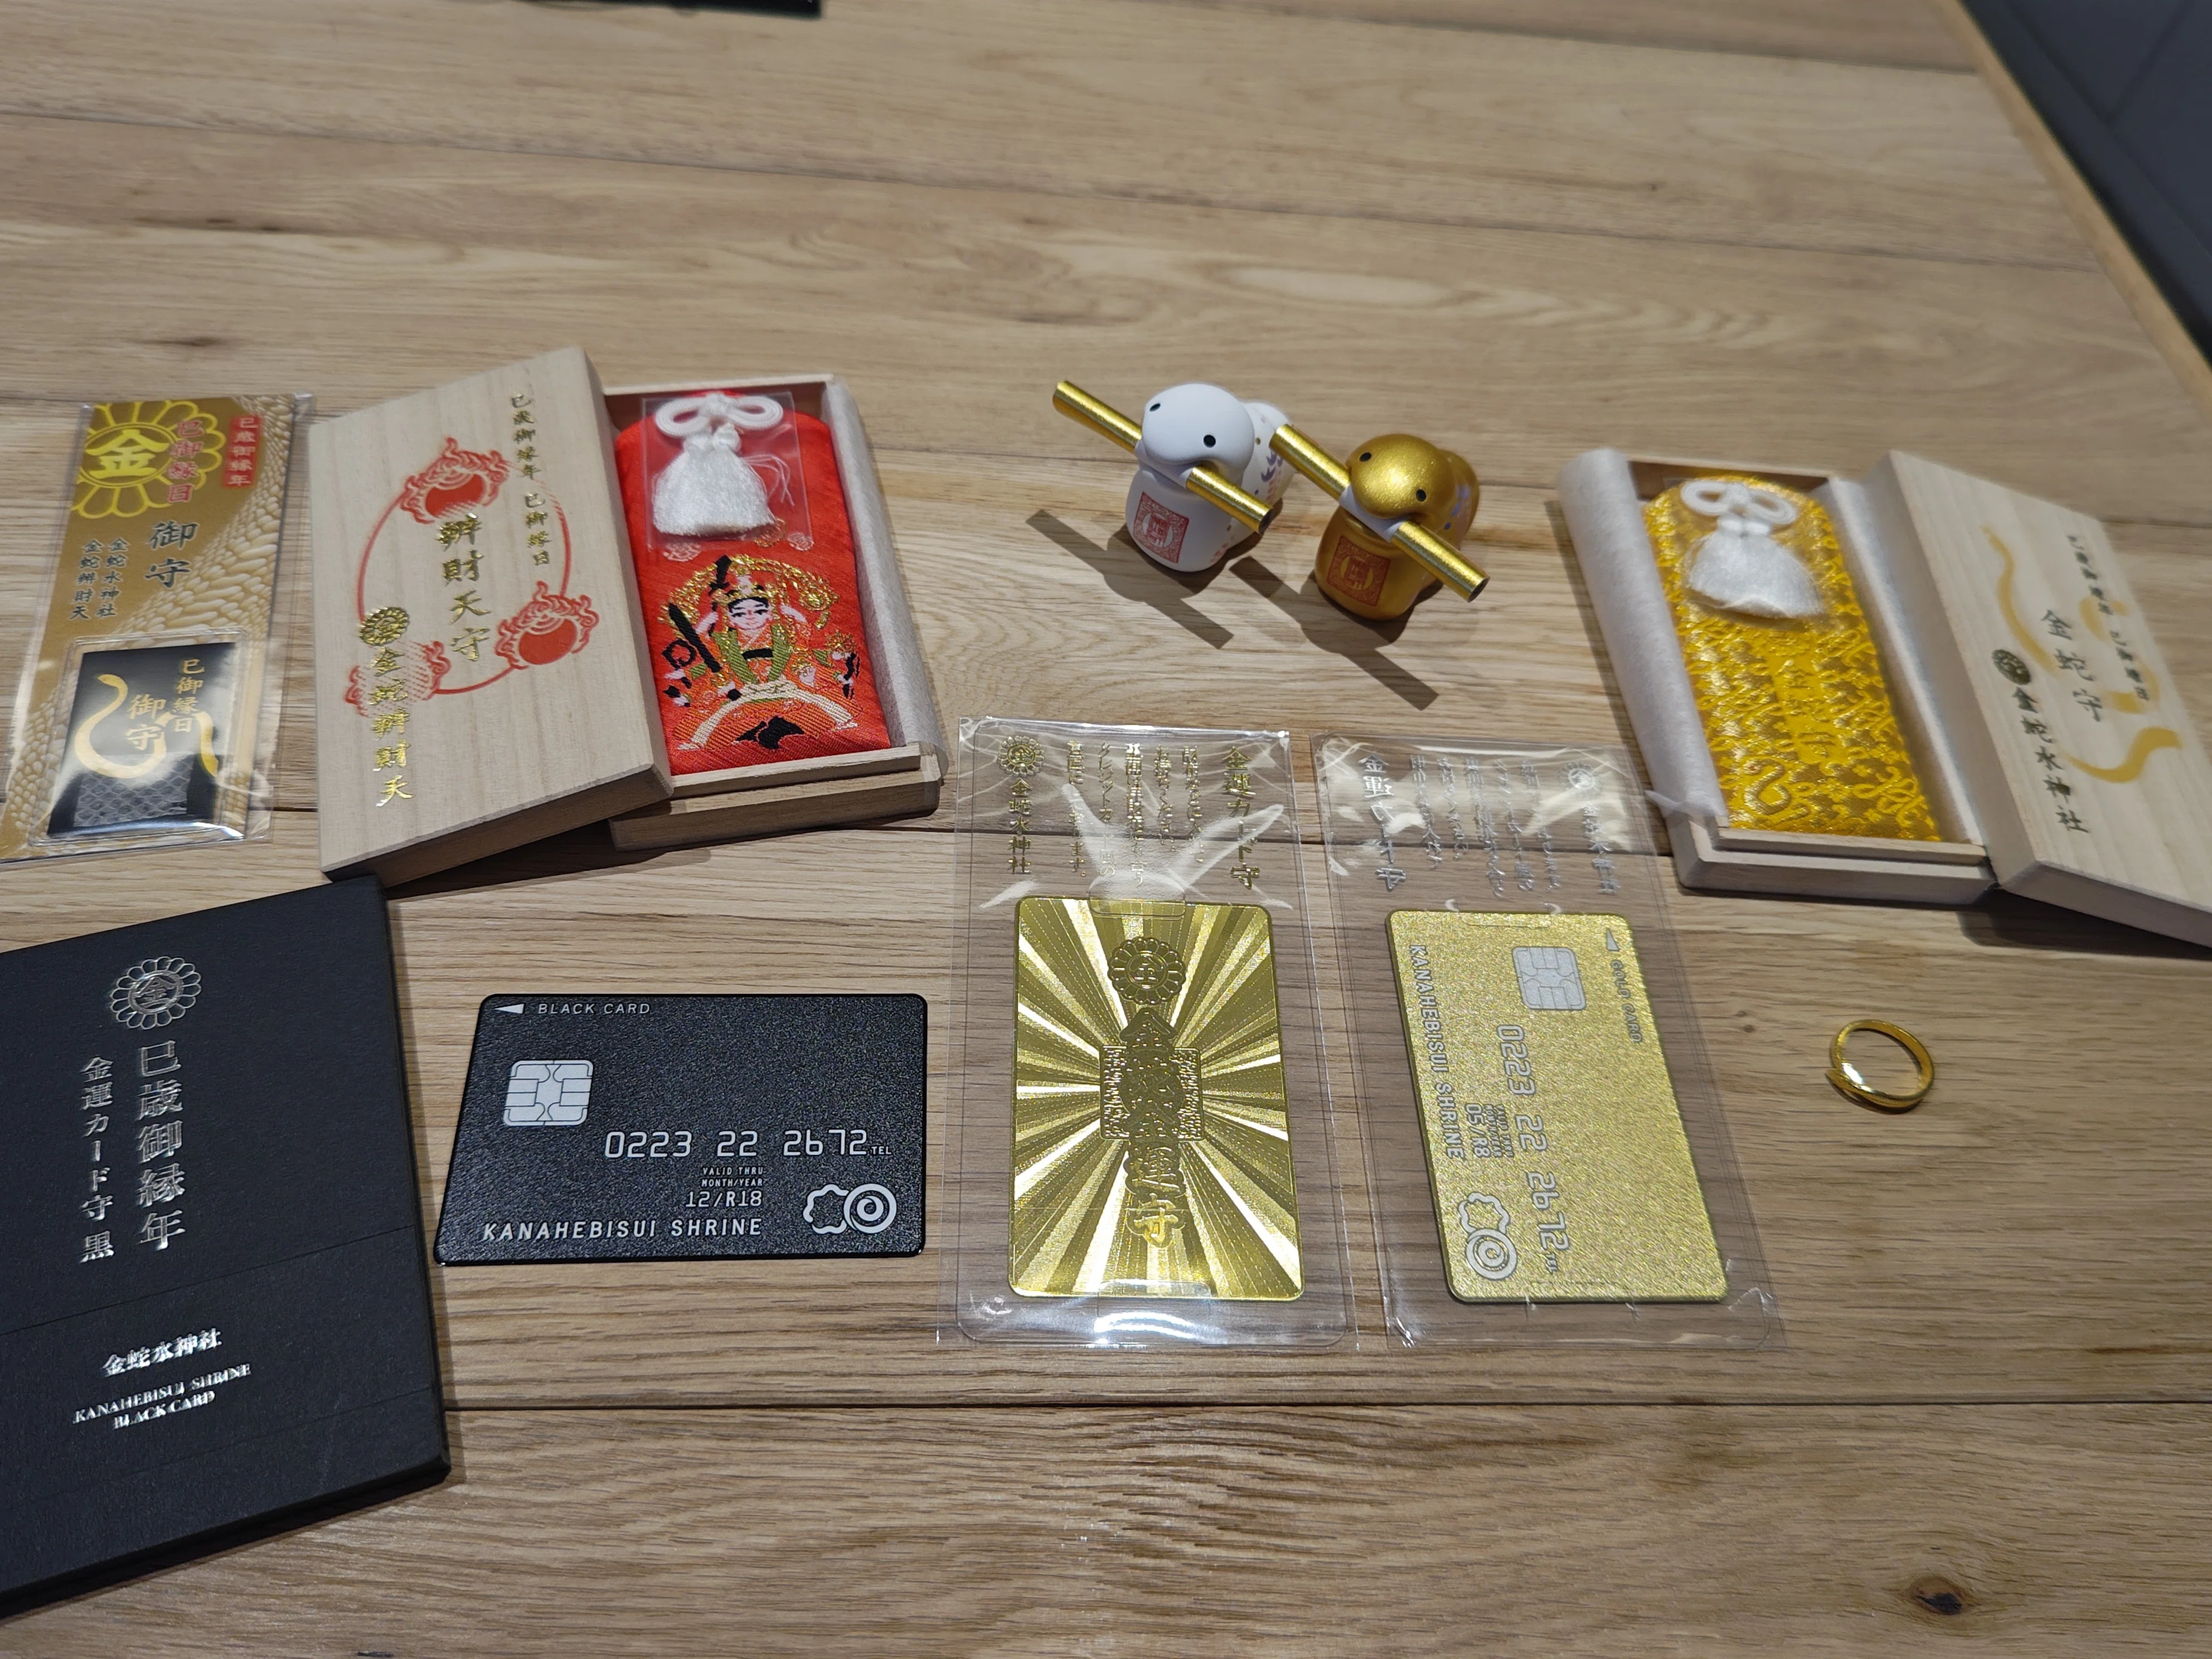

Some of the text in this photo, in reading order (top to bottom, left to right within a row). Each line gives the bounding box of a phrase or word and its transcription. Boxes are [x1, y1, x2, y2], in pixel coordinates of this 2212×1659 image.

[85, 429, 169, 479] 金
[95, 537, 130, 618] 金蛇水神社
[145, 521, 198, 589] 御守
[124, 694, 166, 750] 御守
[173, 658, 205, 733] 巳御縁日
[1008, 778, 1032, 874] 金蛇水神社
[1223, 745, 1260, 890] 金運カード守
[537, 1003, 650, 1015] BLACK CARD
[1611, 959, 1643, 1042] GOLD CARD
[1409, 944, 1465, 1160] KANAHEBISUI SHRINE
[1497, 1024, 1536, 1096] 0223
[80, 1056, 115, 1263] 金運カード守 黒
[135, 1040, 186, 1251] 巳歳御縁年
[604, 1129, 892, 1158] 0223 22 2672 TEL
[1466, 1103, 1491, 1158] 05/R8
[1515, 1115, 1548, 1151] 22
[685, 1190, 763, 1208] 12/R18
[701, 1178, 764, 1187] MONTH/YEAR
[702, 1167, 764, 1175] VALID THRU
[481, 1218, 763, 1241] KANAHEBISUI SHRINE
[1527, 1171, 1571, 1251] 2672
[100, 1327, 222, 1377] 金蛇水神社
[72, 1364, 251, 1424] KANAHEBISUI SHRINE
[113, 1390, 216, 1430] BLACK CARD
